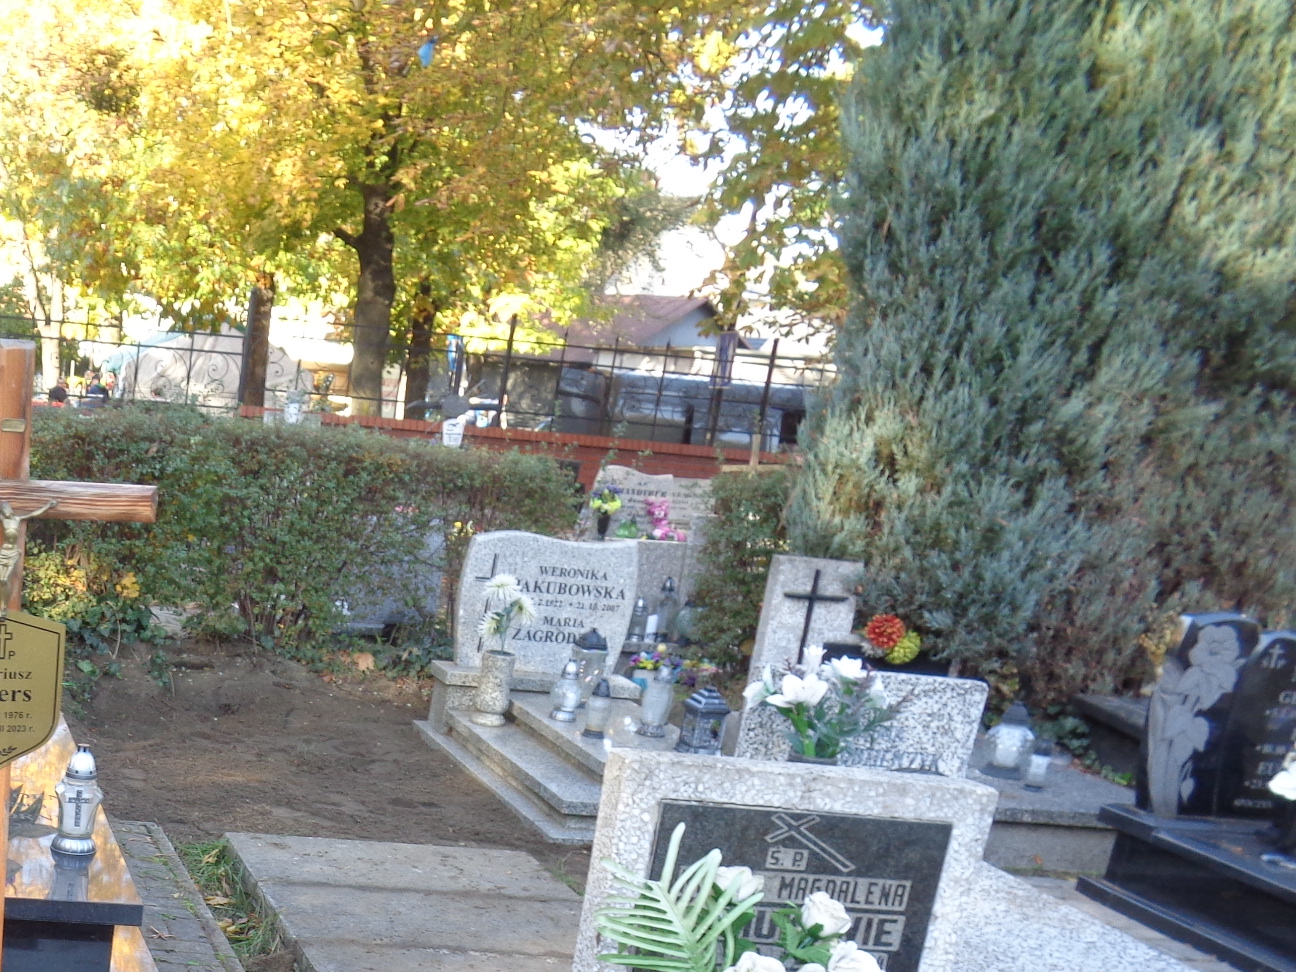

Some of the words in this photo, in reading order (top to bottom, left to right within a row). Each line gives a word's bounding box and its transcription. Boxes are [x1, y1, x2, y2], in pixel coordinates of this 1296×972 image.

[539, 565, 609, 581] WERONIKA
[516, 579, 626, 600] JAKUBOWSKA
[543, 616, 585, 628] MARIA
[8, 650, 16, 660] P
[6, 725, 27, 733] 2023
[777, 875, 906, 908] MAGDALENA
